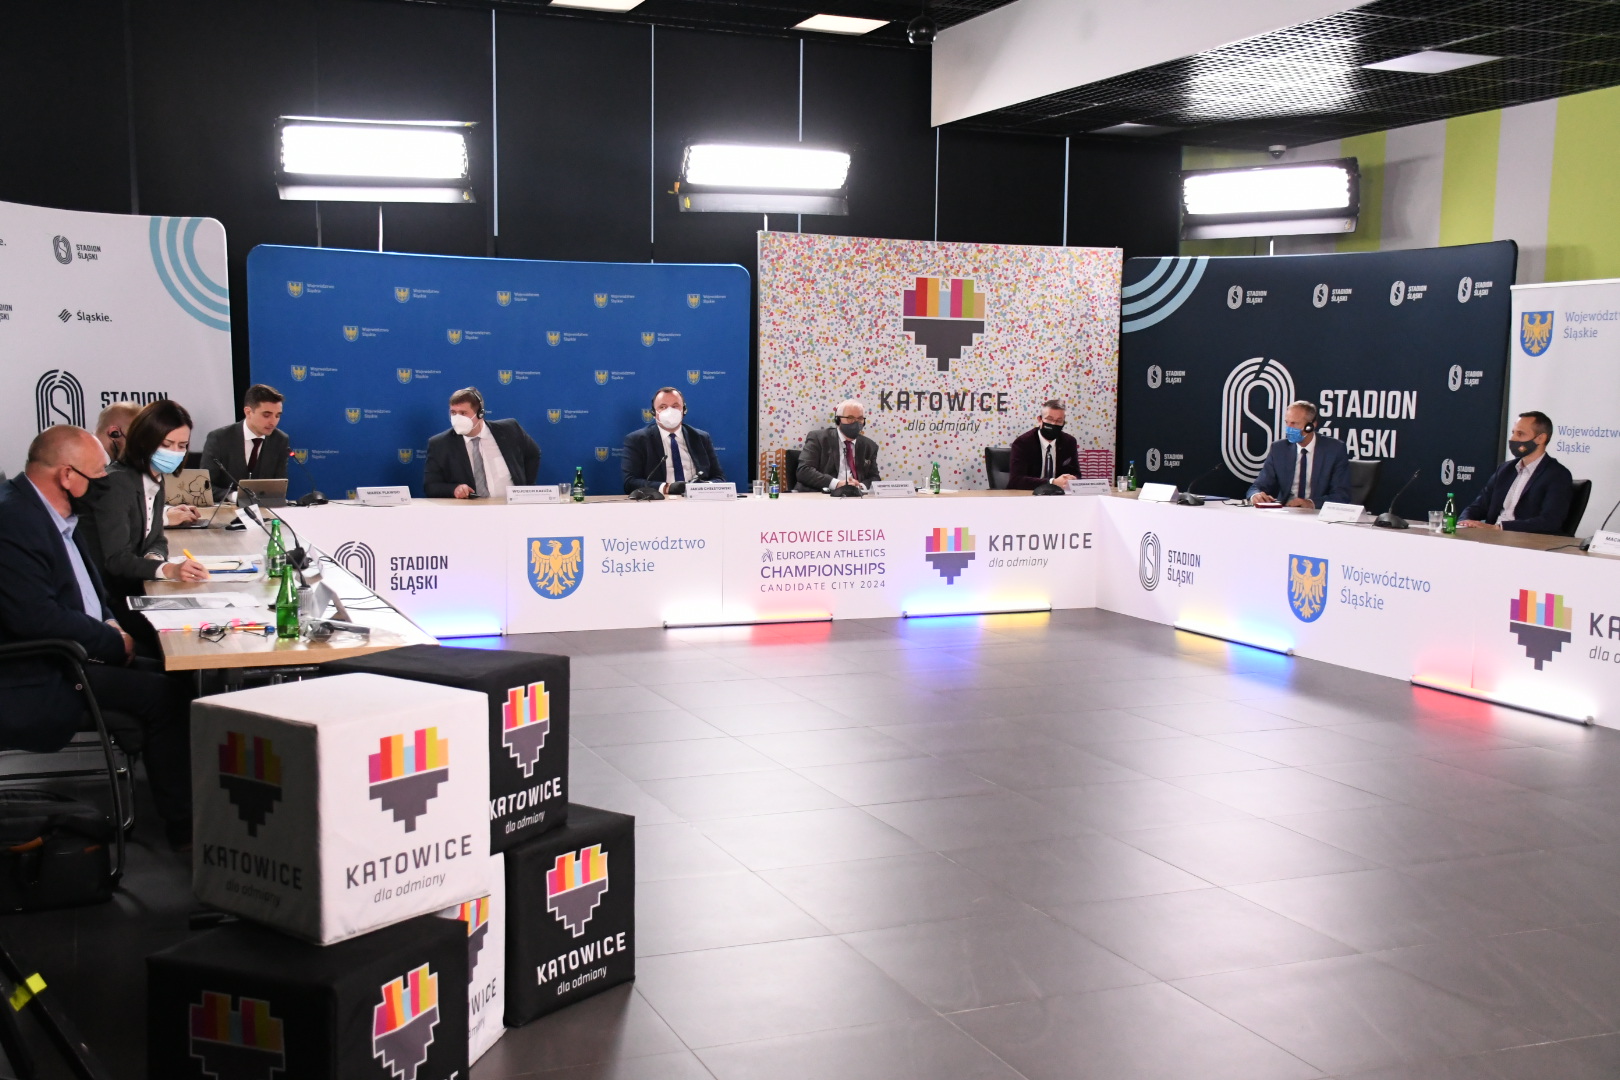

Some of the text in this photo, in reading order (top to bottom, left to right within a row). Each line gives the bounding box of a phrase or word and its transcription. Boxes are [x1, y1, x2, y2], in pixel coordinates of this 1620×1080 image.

[76, 244, 101, 252] STADION
[77, 310, 112, 323] Śląskie.
[1563, 326, 1598, 341] Śląskie
[1465, 370, 1483, 378] STADION
[880, 390, 1009, 413] KATOWICE
[1319, 389, 1418, 420] STADION
[907, 419, 981, 434] dla odmiany
[1556, 440, 1590, 455] Śląskie
[601, 536, 706, 554] Województwo
[760, 529, 885, 544] KATOWICE SILESIA
[989, 532, 1093, 552] KATOWICE
[390, 555, 449, 571] STADION
[776, 548, 885, 561] EUROPEAN ATHLETICS
[989, 556, 1049, 569] dla odmiany
[1167, 549, 1201, 568] STADION
[601, 557, 656, 577] Śląskie
[760, 562, 885, 579] CHAMPIONSHIPS
[390, 573, 438, 595] ŚLĄSKI
[760, 580, 885, 593] CANDIDATE CITY 2024
[1167, 566, 1195, 588] ŚLĄSKI
[1341, 564, 1431, 593] Województwo
[1340, 588, 1384, 610] Śląskie
[1589, 646, 1610, 661] dla
[490, 777, 562, 821] KATOWICE
[506, 811, 545, 834] dla odmiany
[203, 843, 303, 891] KATOWICE
[346, 834, 472, 889] KATOWICE
[374, 871, 446, 903] dla odmiany
[536, 931, 627, 985] KATOWICE
[557, 965, 607, 996] dla odmiany
